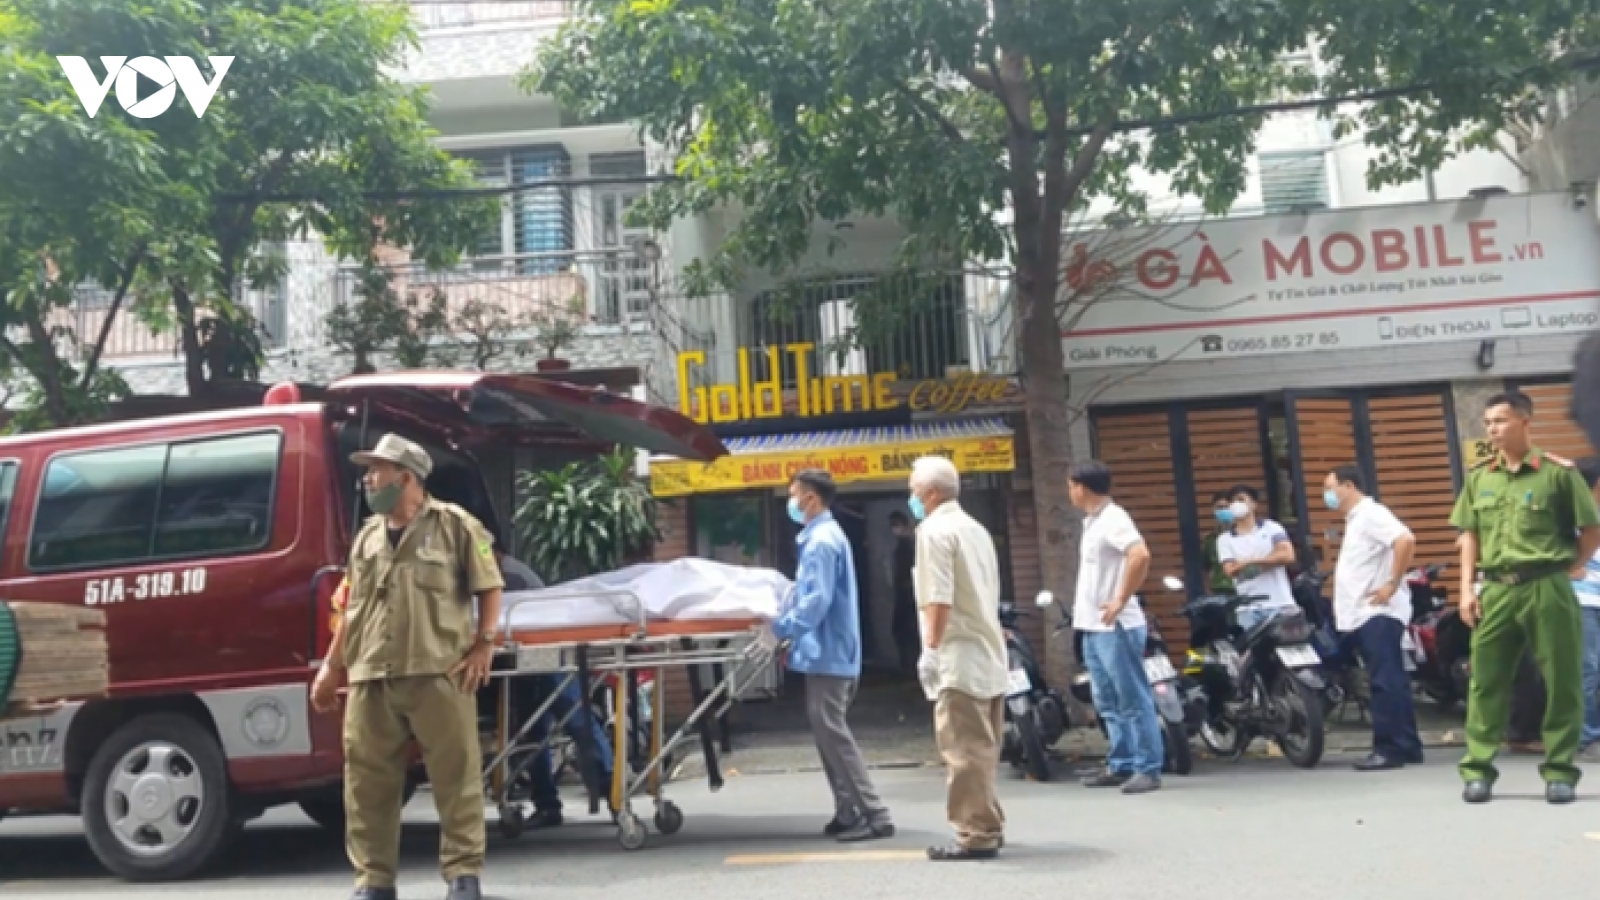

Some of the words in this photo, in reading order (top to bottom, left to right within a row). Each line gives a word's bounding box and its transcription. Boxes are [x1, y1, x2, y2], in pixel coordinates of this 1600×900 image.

[1136, 231, 1233, 290] GÀ
[1536, 310, 1599, 329] Laptop
[742, 457, 782, 483] BÁNH
[84, 567, 208, 606] 51A-319.10
